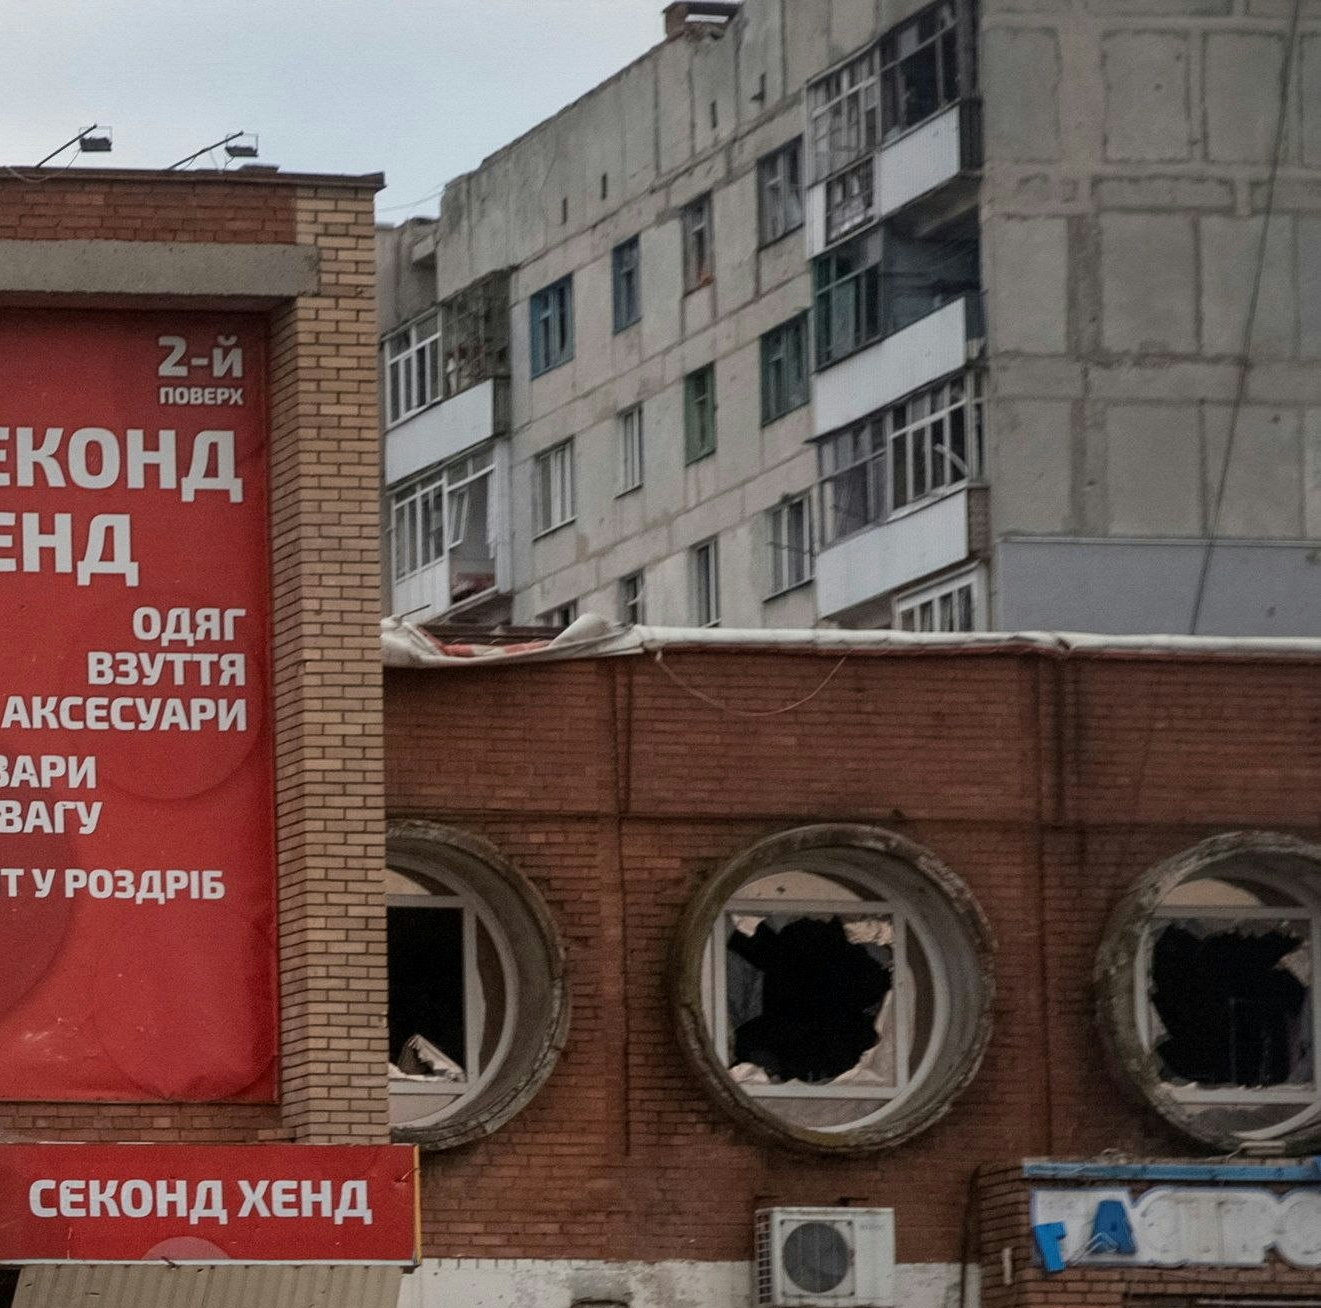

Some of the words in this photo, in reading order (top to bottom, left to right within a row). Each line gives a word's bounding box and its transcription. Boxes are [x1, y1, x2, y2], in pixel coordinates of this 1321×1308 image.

[158, 336, 243, 378] 2-Й
[159, 387, 244, 405] ПОВЕРХ
[133, 607, 245, 646] ОДЯГ
[88, 652, 245, 685] ВЗУТТЯ
[1, 696, 246, 731] АКСЕСУАРИ
[32, 869, 55, 898] У
[65, 869, 225, 904] РОЗДРІБ
[29, 1180, 227, 1224] СЕКОНД
[238, 1180, 372, 1224] ХЕНД
